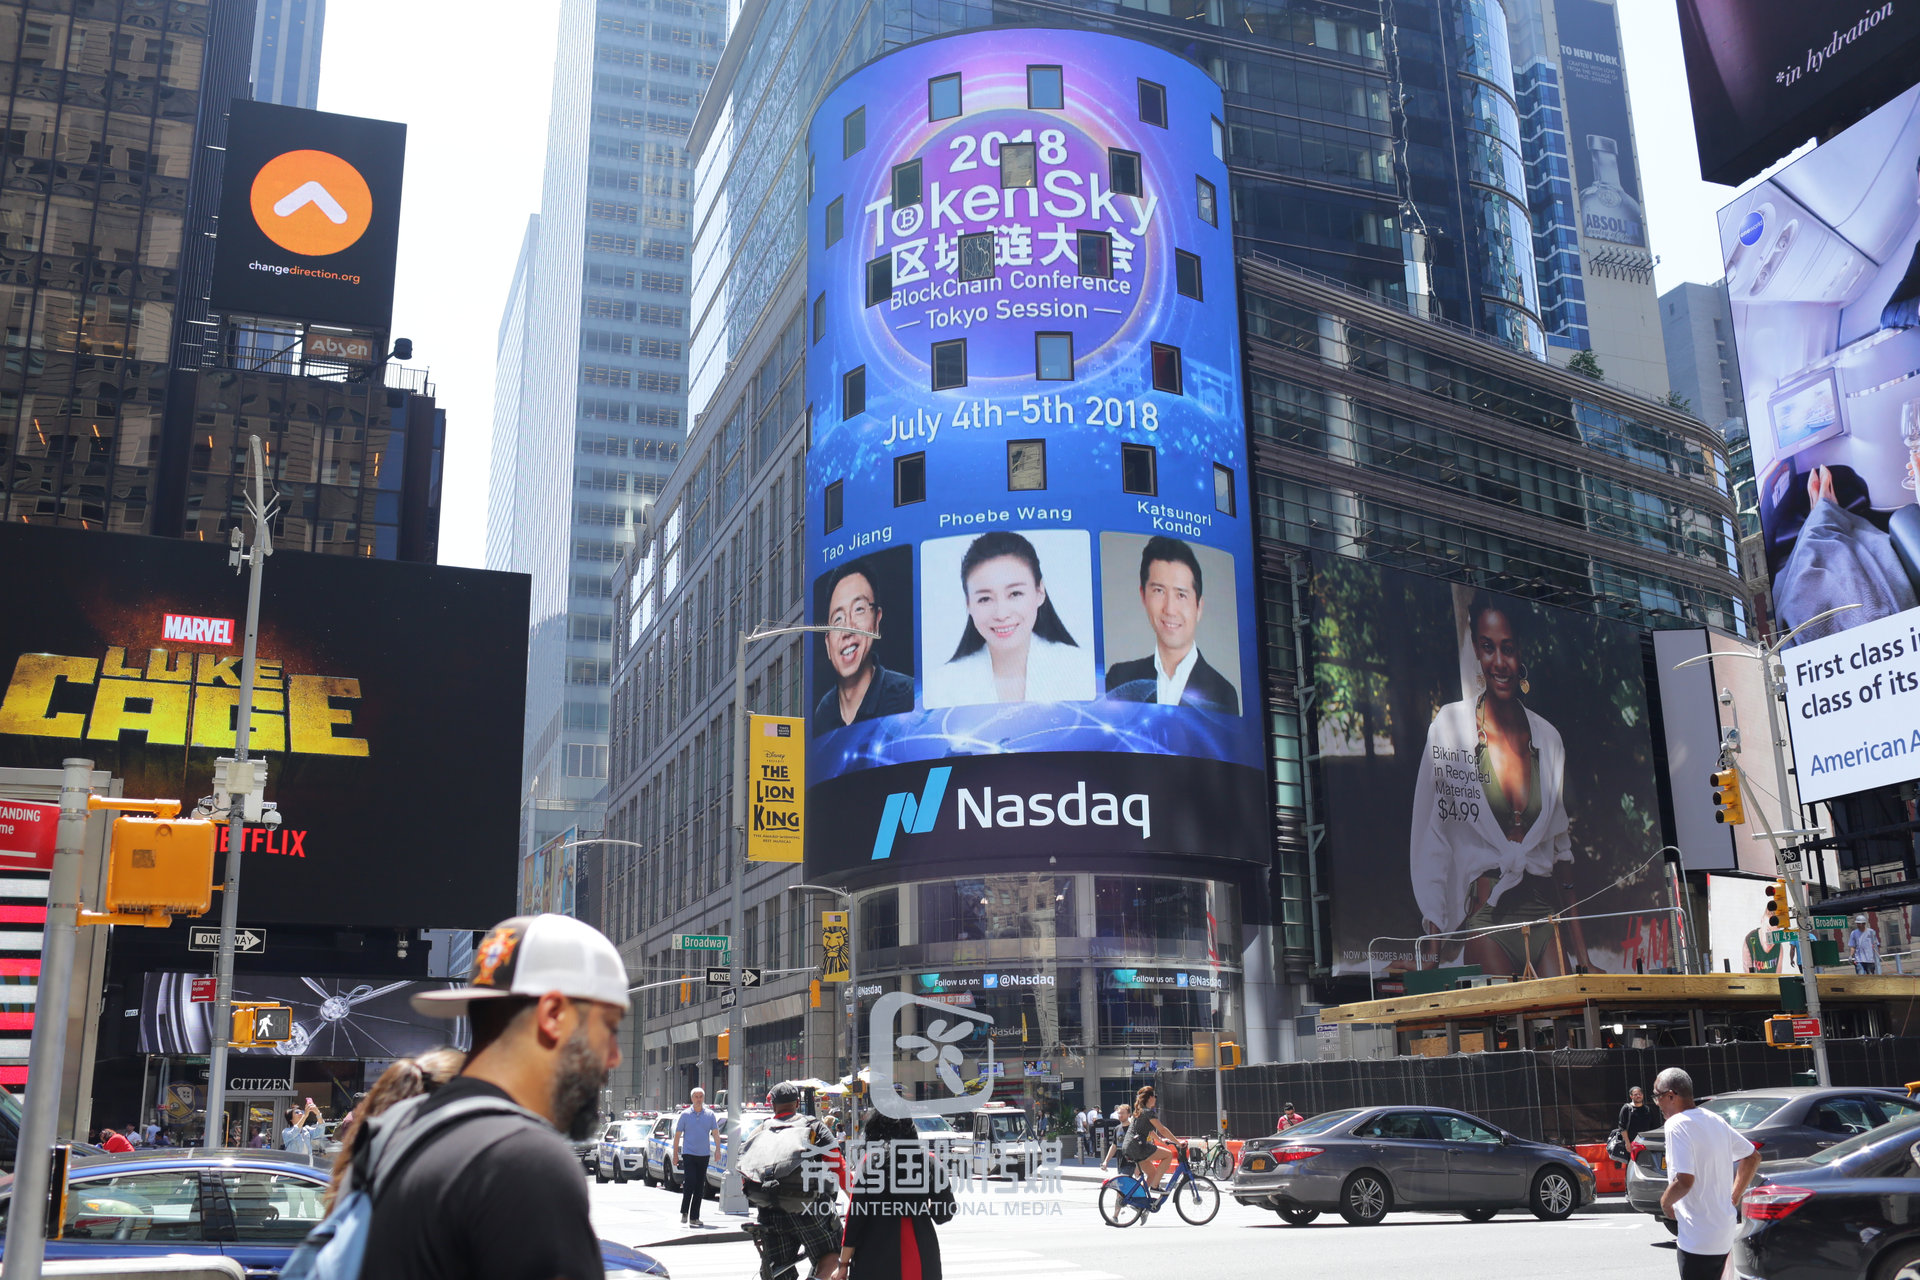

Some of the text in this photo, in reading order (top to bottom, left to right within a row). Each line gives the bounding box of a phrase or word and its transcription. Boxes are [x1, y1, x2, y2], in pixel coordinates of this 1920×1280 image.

[1807, 2, 1893, 72] hydration
[1560, 45, 1572, 56] TO
[1573, 47, 1592, 60] NEW
[865, 169, 1159, 248] TokenSky
[1741, 219, 1763, 238] oneworld
[248, 260, 360, 284] changedirection.org
[891, 270, 1132, 312] BlockChain Conference
[925, 298, 1088, 330] Tokyo Session
[311, 338, 368, 357] Absen
[882, 394, 1160, 446] July 4th-5th 2018
[939, 506, 1073, 528] Phoebe Wang
[1137, 500, 1213, 528] Katsunori
[1152, 516, 1202, 537] Kondo
[822, 524, 893, 564] Tao Jiang
[163, 615, 233, 645] MARVEL
[102, 645, 284, 690] LUKE
[1796, 654, 1845, 687] First
[1850, 643, 1904, 670] class
[0, 652, 370, 757] CAGE
[1801, 670, 1919, 720] class of its
[764, 750, 785, 760] Disney
[1433, 745, 1480, 767] Bikini Top
[1810, 737, 1907, 777] American
[761, 765, 788, 778] THE
[1434, 763, 1491, 784] in Recycled
[1435, 781, 1481, 799] Materials
[957, 781, 1151, 839] Nasdaq
[1438, 797, 1479, 823] $4.99
[1789, 863, 1801, 871] LANE
[1815, 917, 1846, 928] Broadway
[201, 935, 220, 944] ONE
[684, 936, 727, 950] Broadway
[1621, 916, 1669, 972] H&M
[1773, 932, 1780, 940] W
[1782, 932, 1791, 940] 43
[1344, 950, 1360, 960] NOW
[1371, 951, 1397, 961] STORES
[1399, 953, 1413, 961] AND
[1415, 954, 1439, 962] NLINE
[714, 973, 729, 981] ONE
[934, 979, 957, 987] Follow
[968, 978, 980, 986] on:
[999, 974, 1055, 987] @Nasdaq
[1132, 975, 1155, 983] Follow
[1189, 975, 1222, 988] @Nasdaq
[857, 984, 882, 998] @Nasdaq
[948, 995, 971, 1004] CITIES
[230, 1077, 292, 1090] CITIZEN
